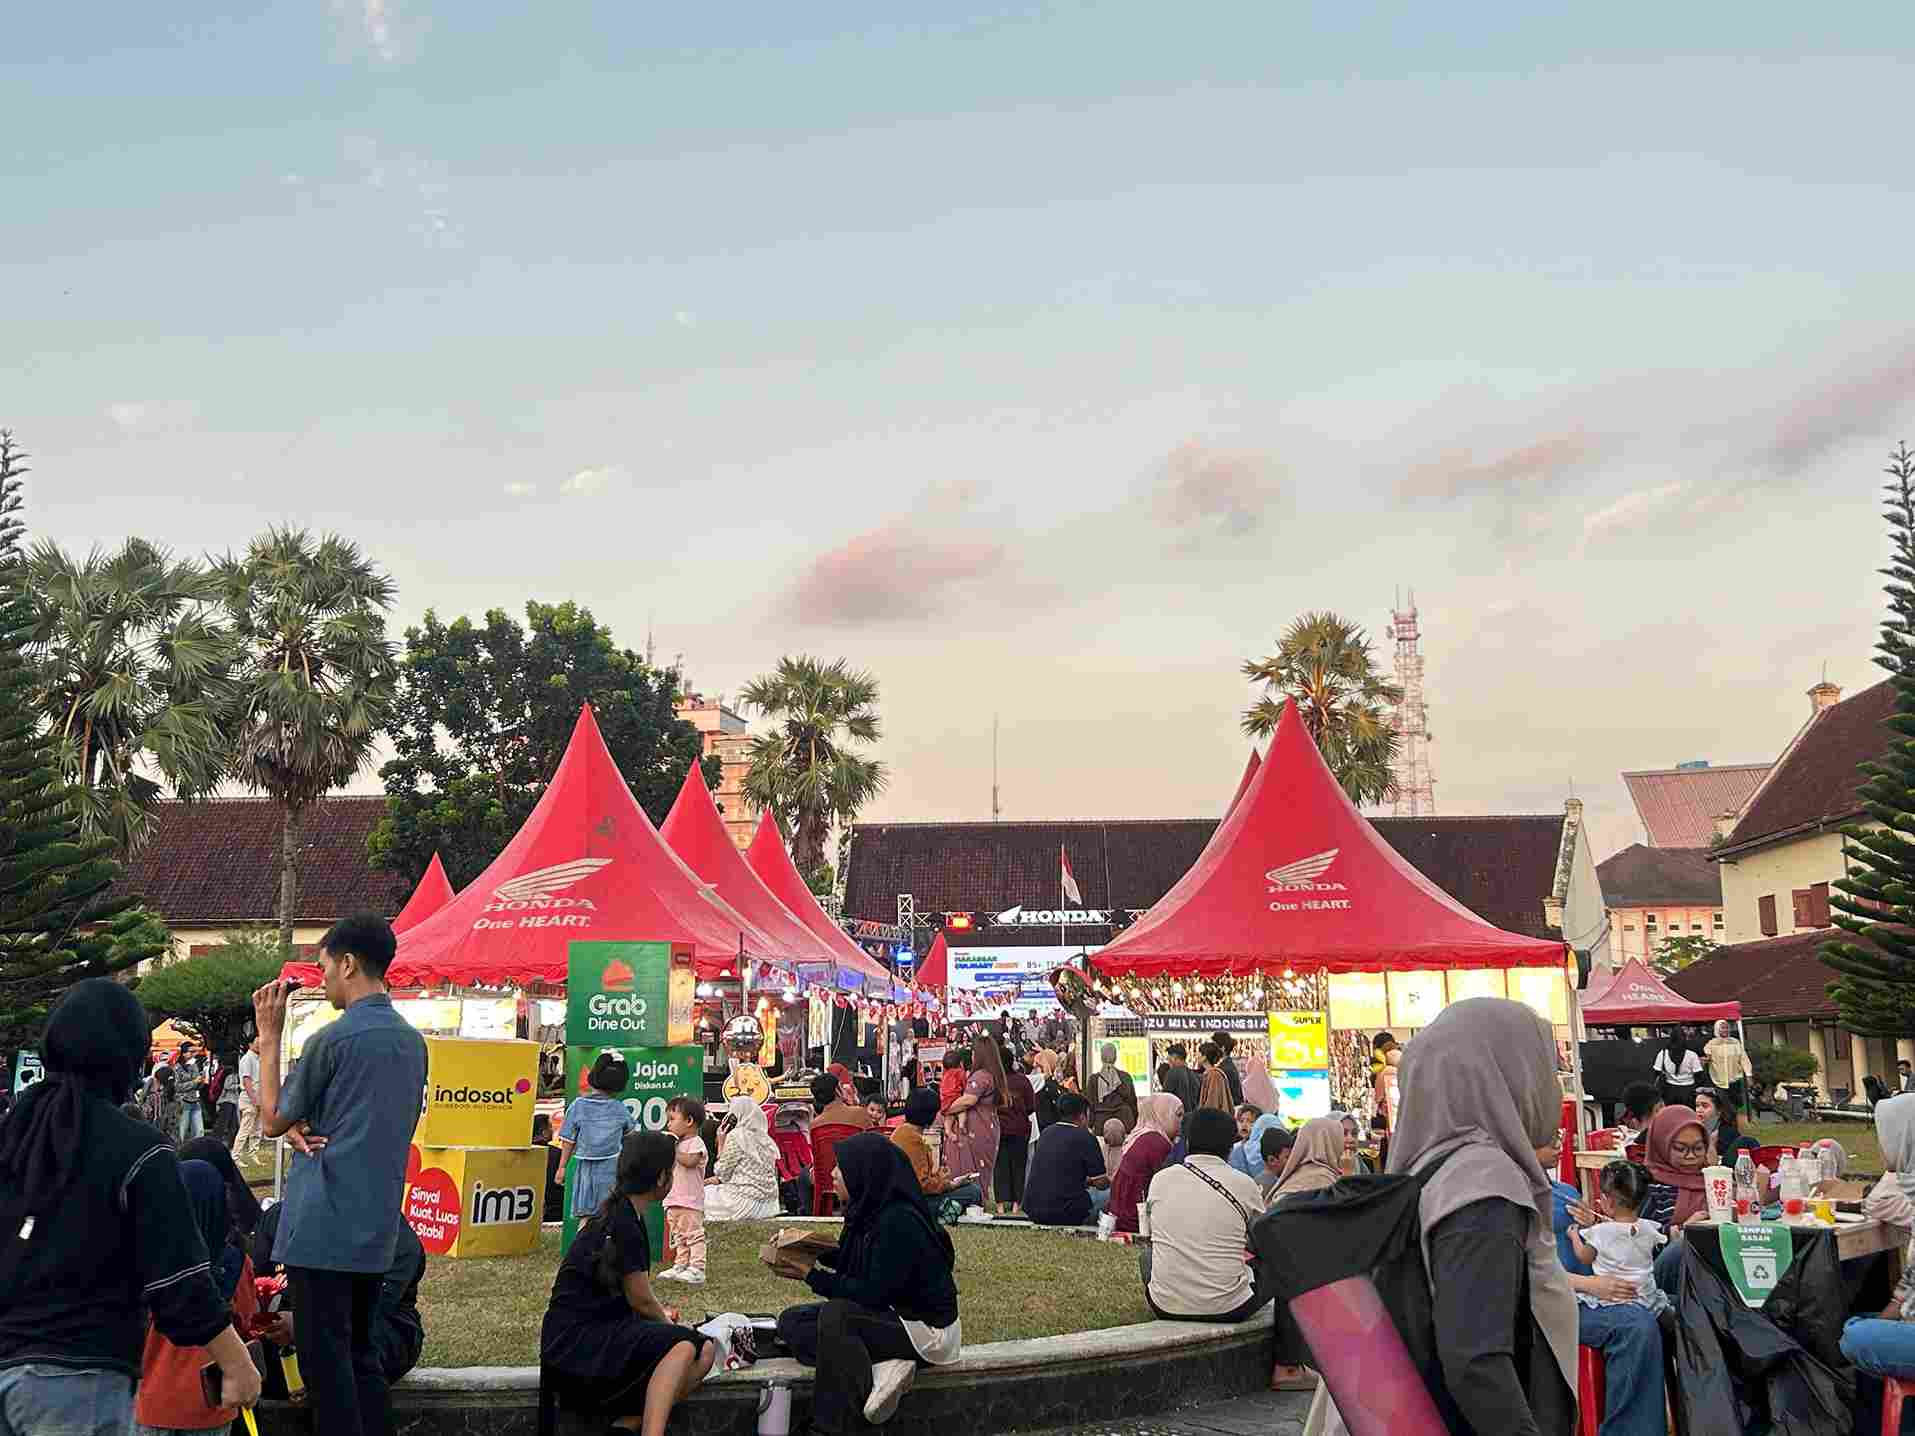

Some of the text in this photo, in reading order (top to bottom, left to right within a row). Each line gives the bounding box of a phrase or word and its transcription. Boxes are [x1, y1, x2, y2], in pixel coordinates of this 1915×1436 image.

[1265, 882, 1348, 893] HONDA
[482, 897, 598, 912] HONDA
[1269, 901, 1298, 911] One
[473, 917, 514, 929] One
[1020, 910, 1105, 923] HONDA
[588, 993, 648, 1016] Grab
[588, 1017, 646, 1031] Dine Out
[1168, 1017, 1197, 1028] MILK
[1200, 1017, 1268, 1029] INDONESIA
[632, 1060, 679, 1080] Jajan
[435, 1084, 514, 1104] indosat
[624, 1096, 668, 1132] 20
[411, 1186, 441, 1205] Sinyal
[436, 1210, 459, 1225] Luas
[416, 1222, 445, 1240] Stabil
